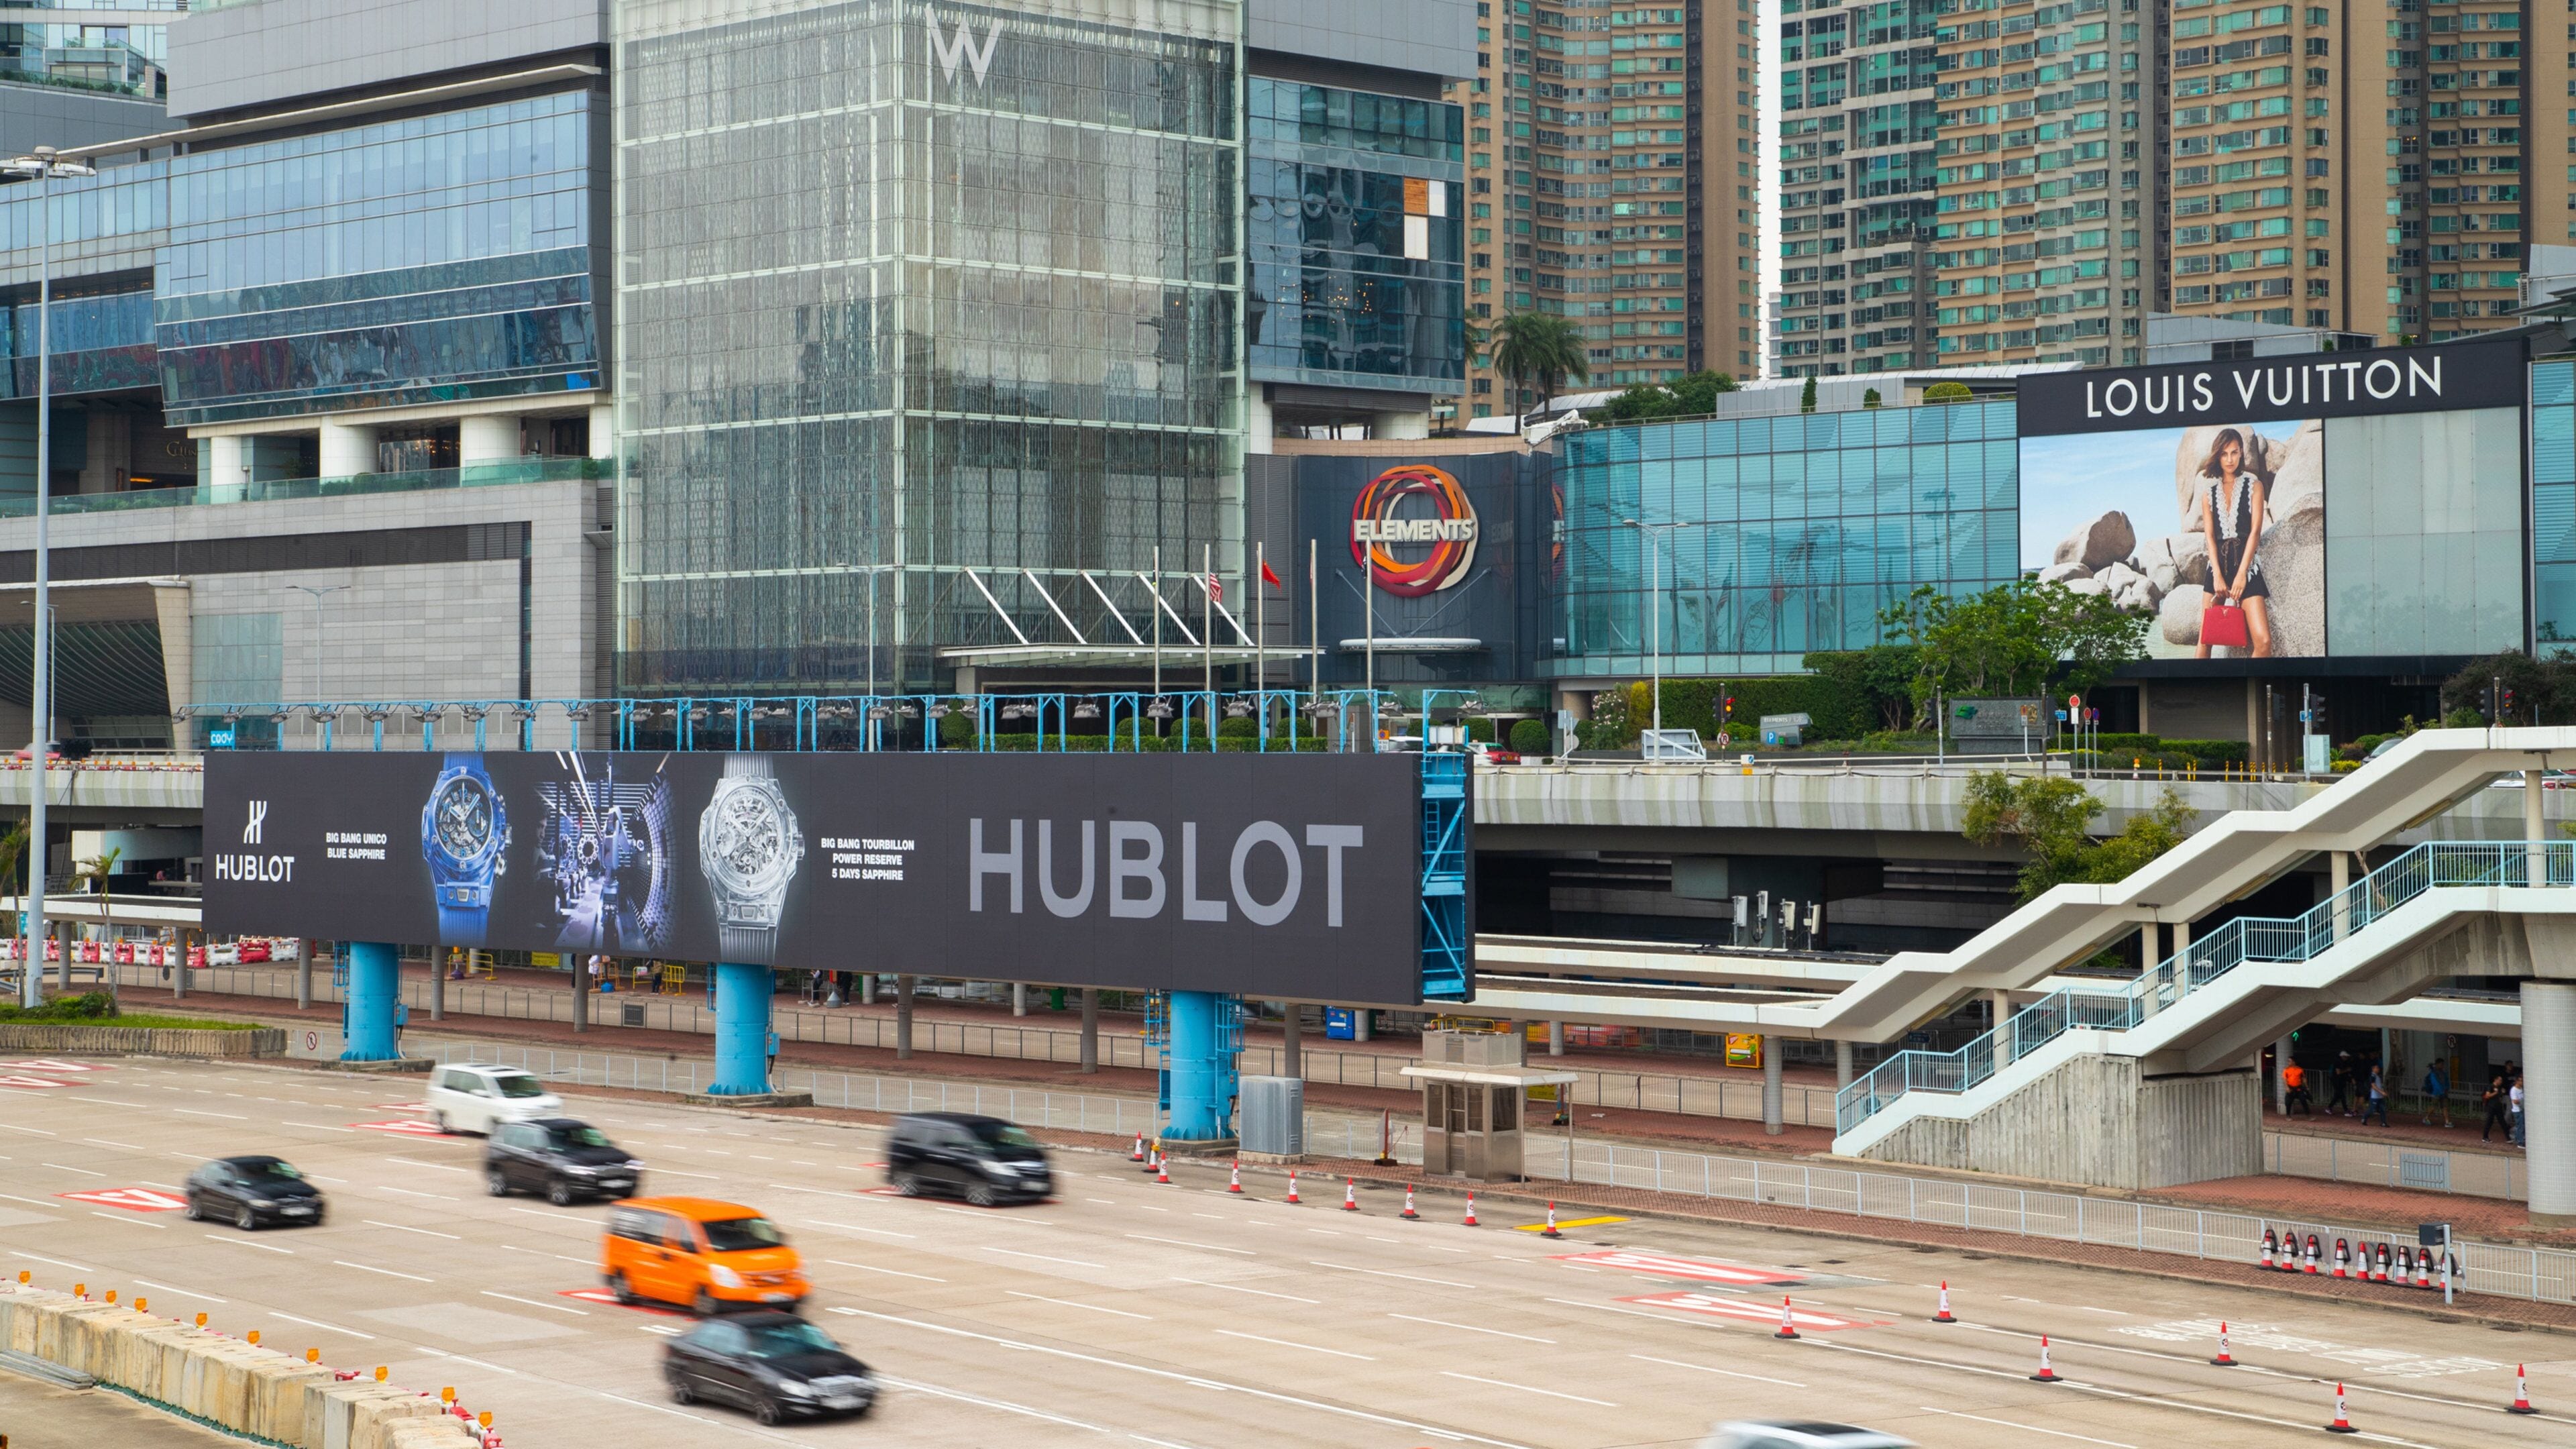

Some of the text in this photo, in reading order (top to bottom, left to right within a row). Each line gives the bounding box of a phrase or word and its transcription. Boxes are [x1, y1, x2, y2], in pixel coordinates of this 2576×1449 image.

[924, 2, 1004, 89] W
[2087, 356, 2441, 418] LOUIS VUITTON
[1354, 519, 1475, 542] ELEMENTS
[1768, 732, 1774, 743] P
[325, 832, 387, 845] BIG BANG UNICO
[820, 837, 915, 851] BIG BANG TOURBILLON
[327, 847, 386, 860] BLUE SAPPHIRE
[832, 853, 903, 865] POWER RESERVE
[215, 853, 295, 882] HUBLOT
[831, 867, 904, 881] 5 DAYS SAPPHIRE
[969, 817, 1364, 928] HUBLOT
